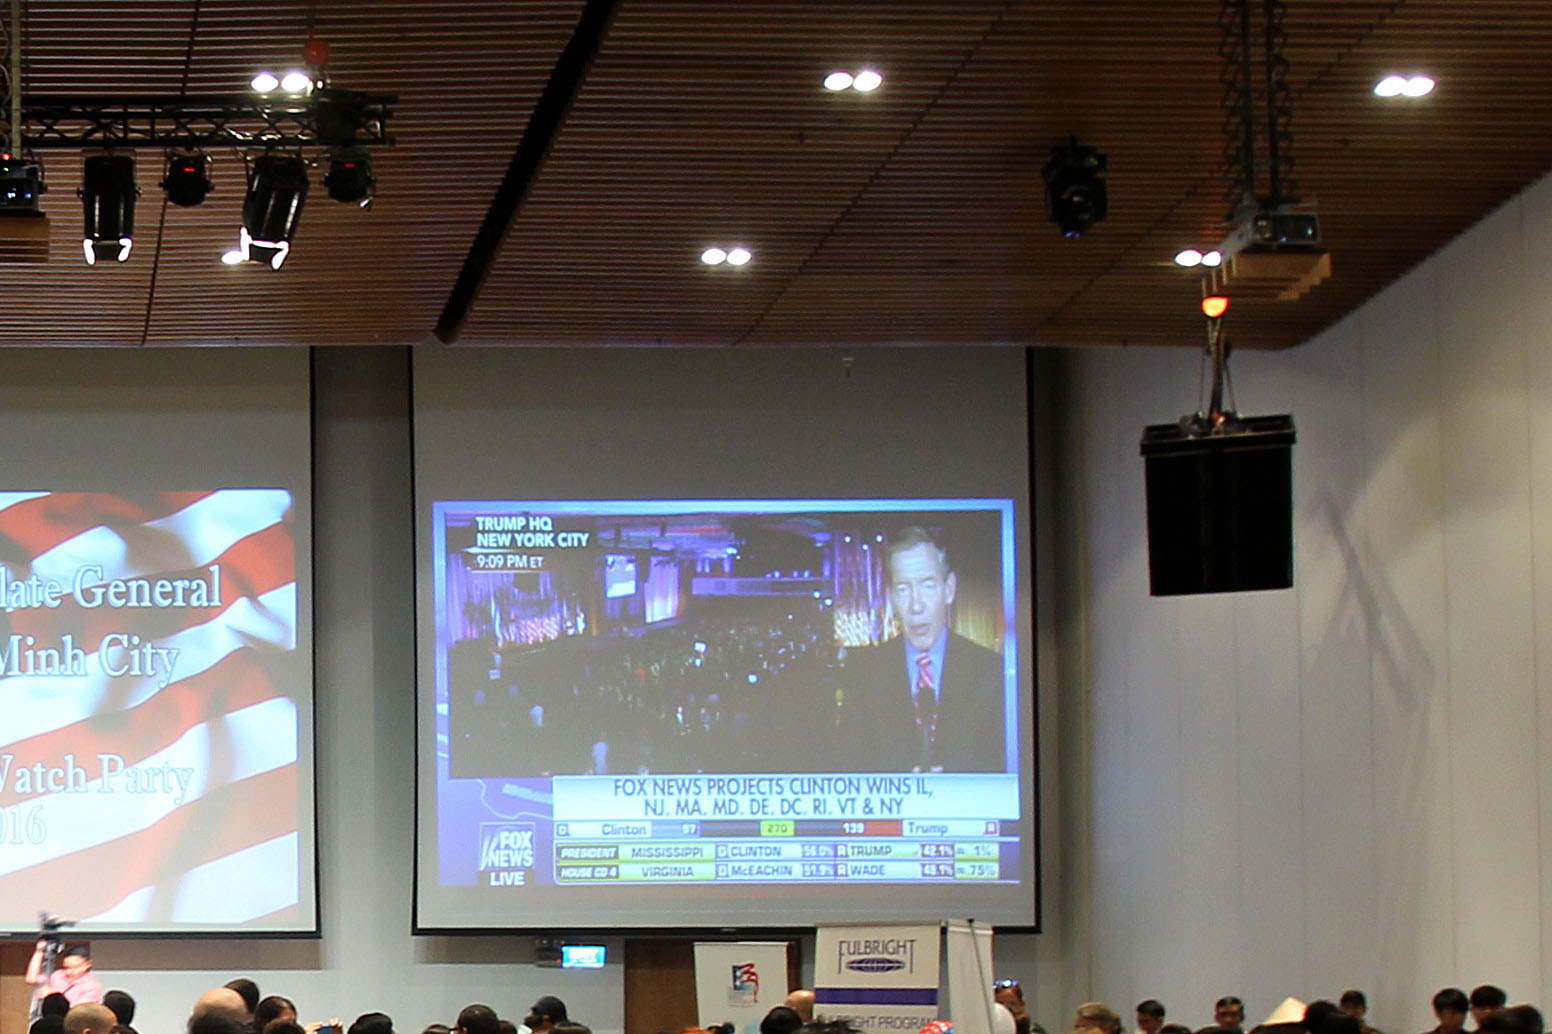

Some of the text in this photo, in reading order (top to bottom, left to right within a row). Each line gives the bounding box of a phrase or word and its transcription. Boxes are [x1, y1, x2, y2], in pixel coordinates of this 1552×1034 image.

[475, 516, 552, 531] TRUMP HQ
[476, 533, 589, 547] NEW YORK CITY
[476, 554, 544, 568] 9:09 PM ET
[72, 564, 222, 608] General
[98, 634, 180, 689] City
[97, 753, 193, 805] Party
[614, 777, 933, 798] FOX NEWS PROJECTS CLINTON WINS IL,
[838, 797, 857, 815] VT
[862, 797, 874, 815] &
[880, 797, 904, 815] NY
[602, 823, 647, 836] Clinton
[767, 824, 788, 834] 270
[908, 821, 948, 836] Trump
[500, 831, 533, 849] FOX
[561, 847, 616, 859] PRESIDENT
[632, 846, 704, 858] MISSISSIPPI
[731, 845, 782, 857] CLINTON
[851, 845, 892, 857] TRUMP
[489, 850, 533, 868] NEWS
[561, 867, 592, 878] HOUSE
[641, 866, 694, 878] VIRGINIA
[731, 865, 793, 877] McEACHIN
[851, 864, 886, 876] WADE
[490, 871, 525, 886] LIVE
[838, 939, 917, 974] FULBRIGHT
